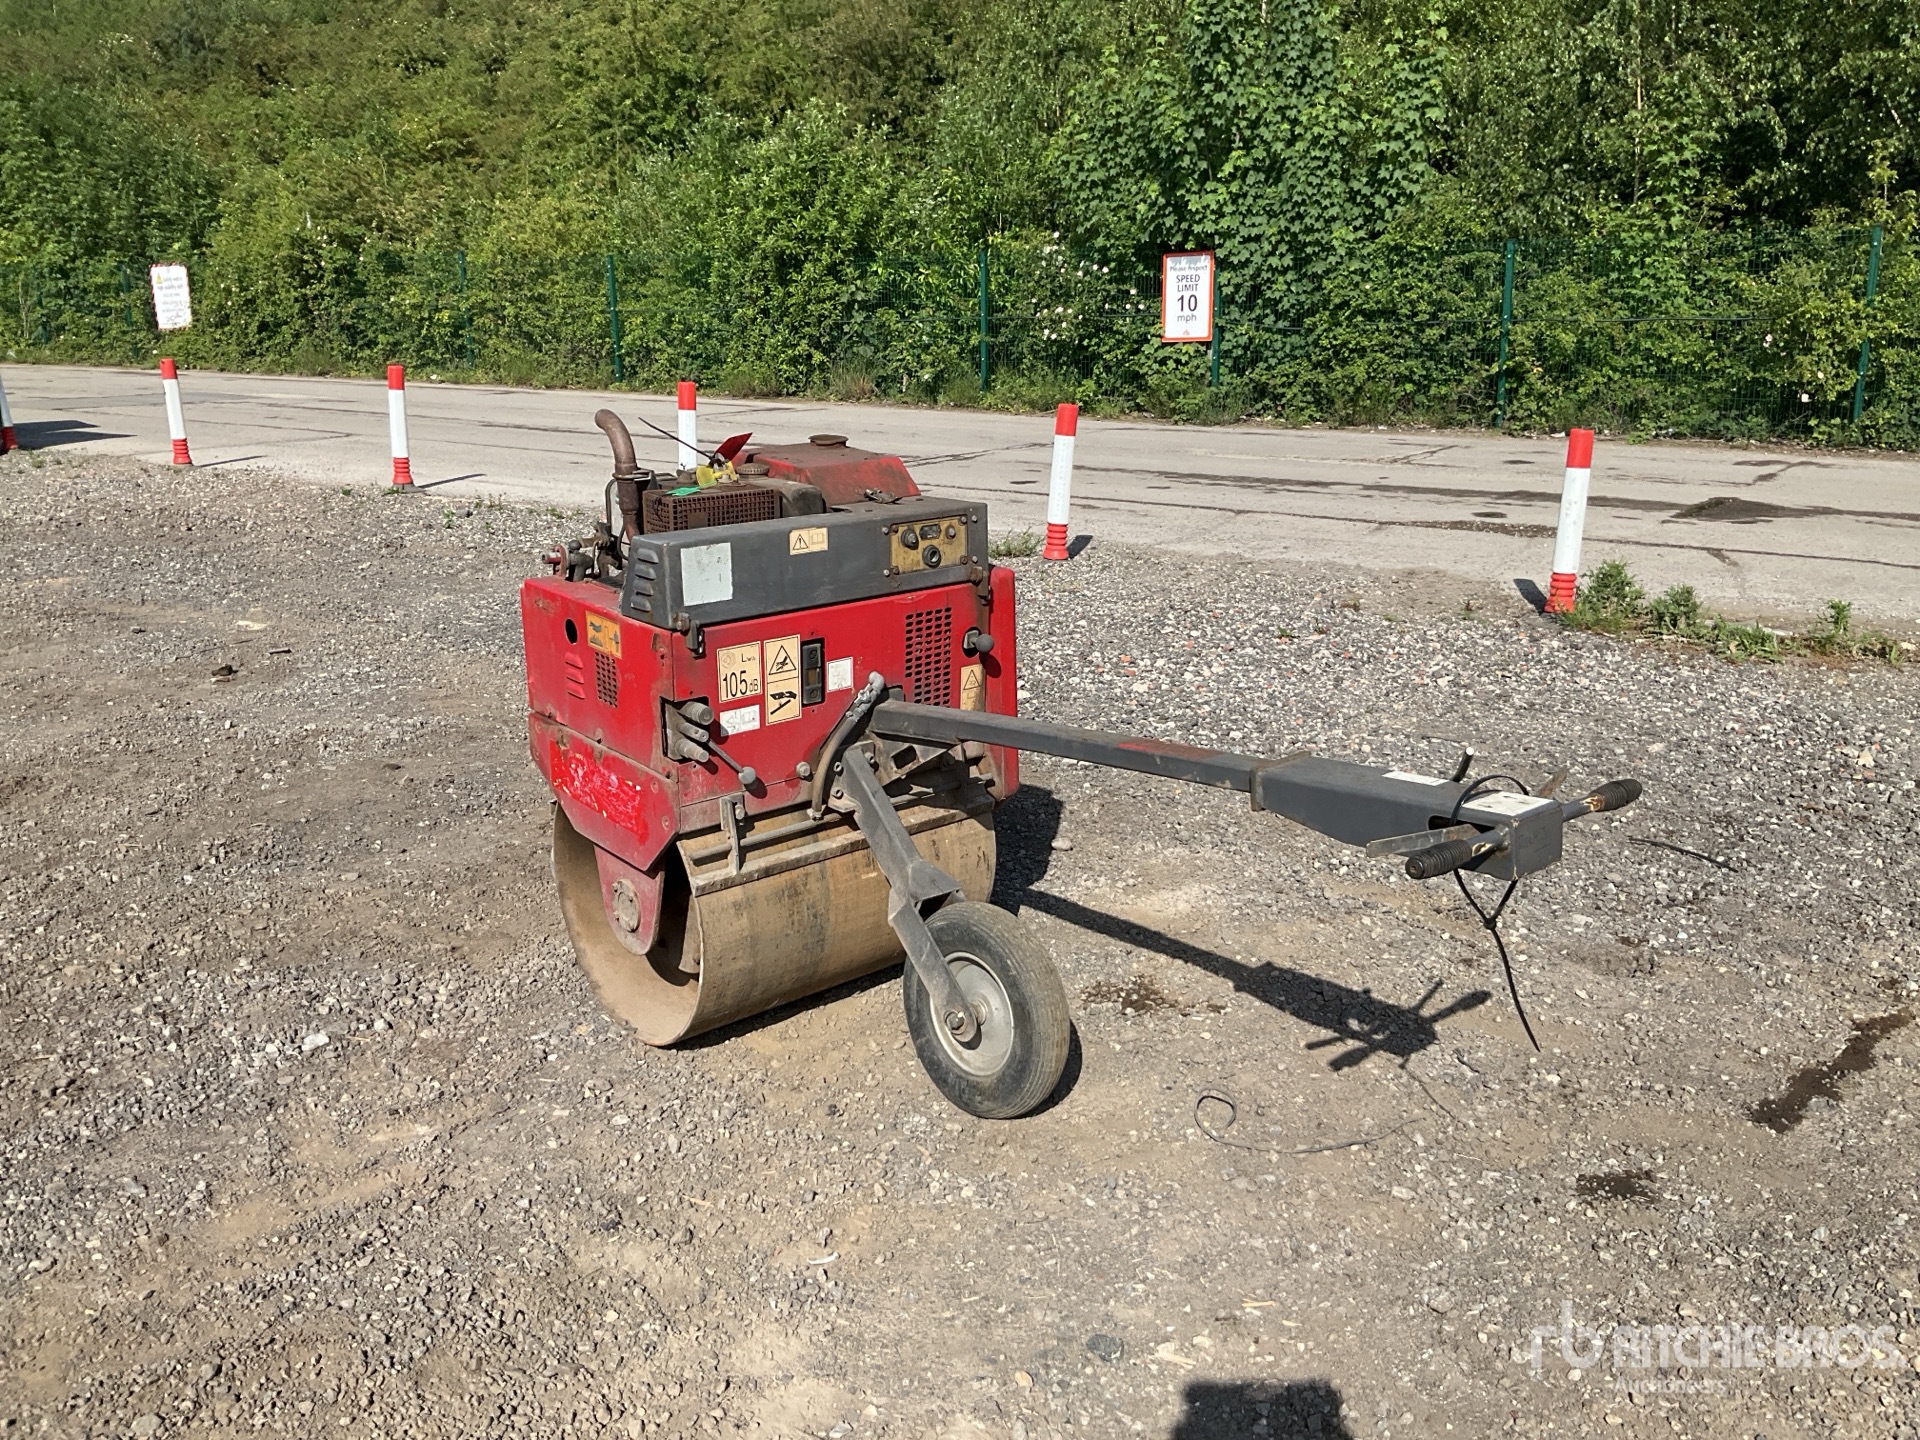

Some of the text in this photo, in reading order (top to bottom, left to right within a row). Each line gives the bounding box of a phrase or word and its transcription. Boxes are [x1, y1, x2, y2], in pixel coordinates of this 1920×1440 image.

[1175, 274, 1201, 284] SPEED
[1177, 283, 1199, 293] LIMIT
[1177, 294, 1198, 312] 10
[1177, 314, 1197, 324] mph
[723, 670, 759, 699] 105 dB
